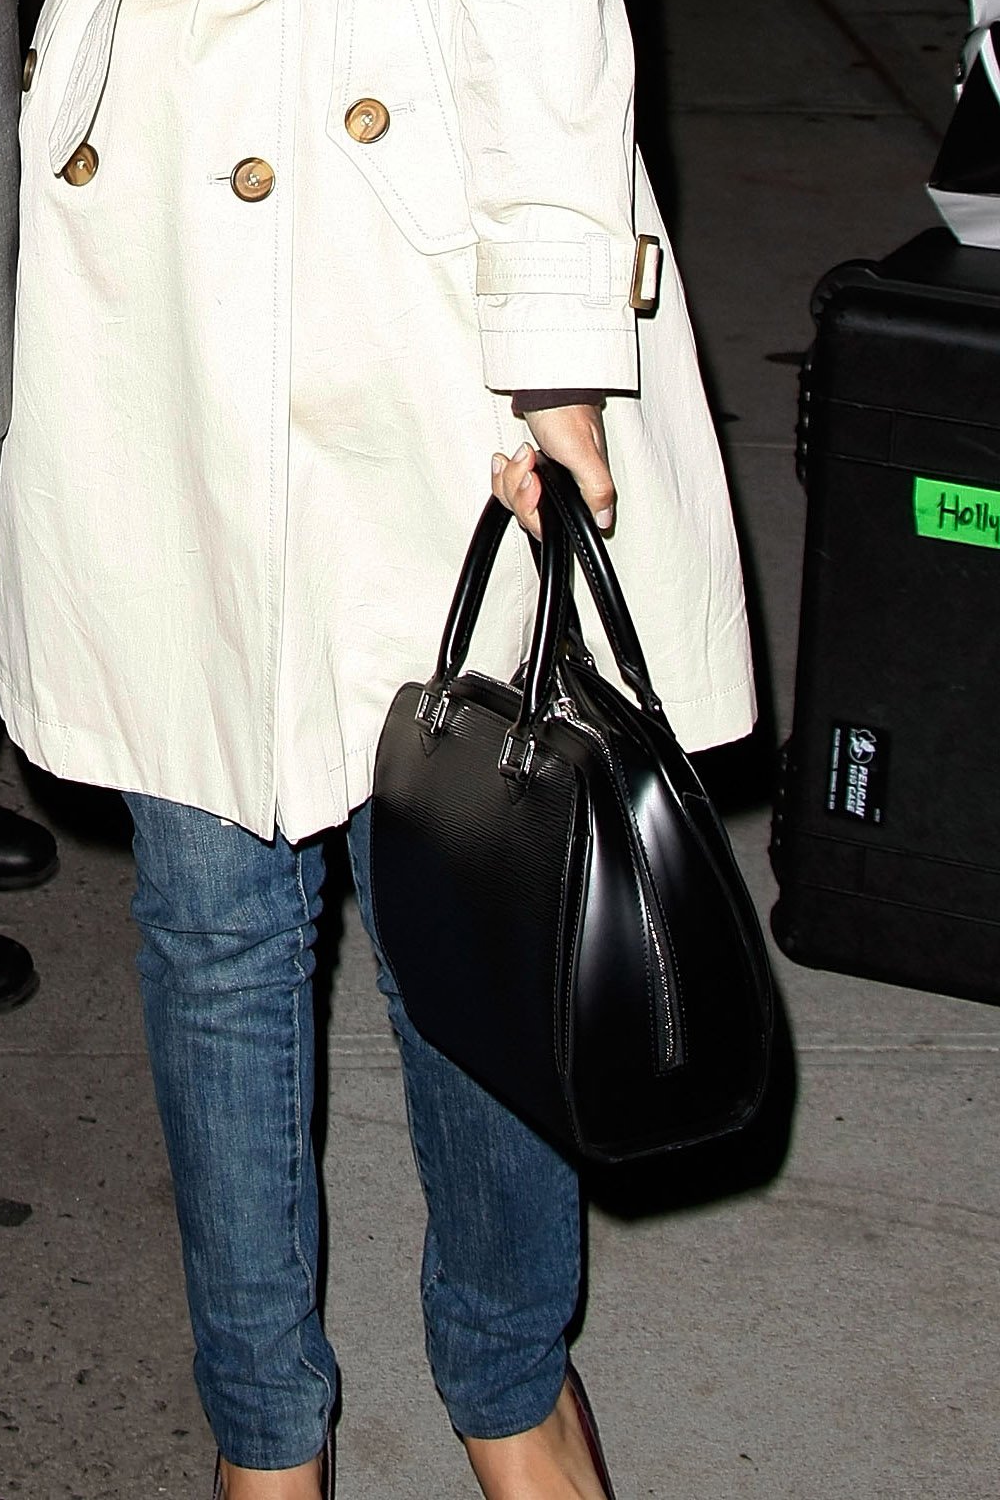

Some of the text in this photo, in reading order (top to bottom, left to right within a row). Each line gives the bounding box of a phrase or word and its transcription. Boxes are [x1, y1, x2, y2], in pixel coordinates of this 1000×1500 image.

[937, 491, 1000, 544] Holly
[846, 786, 857, 813] CASE
[855, 765, 868, 817] PELICAN
